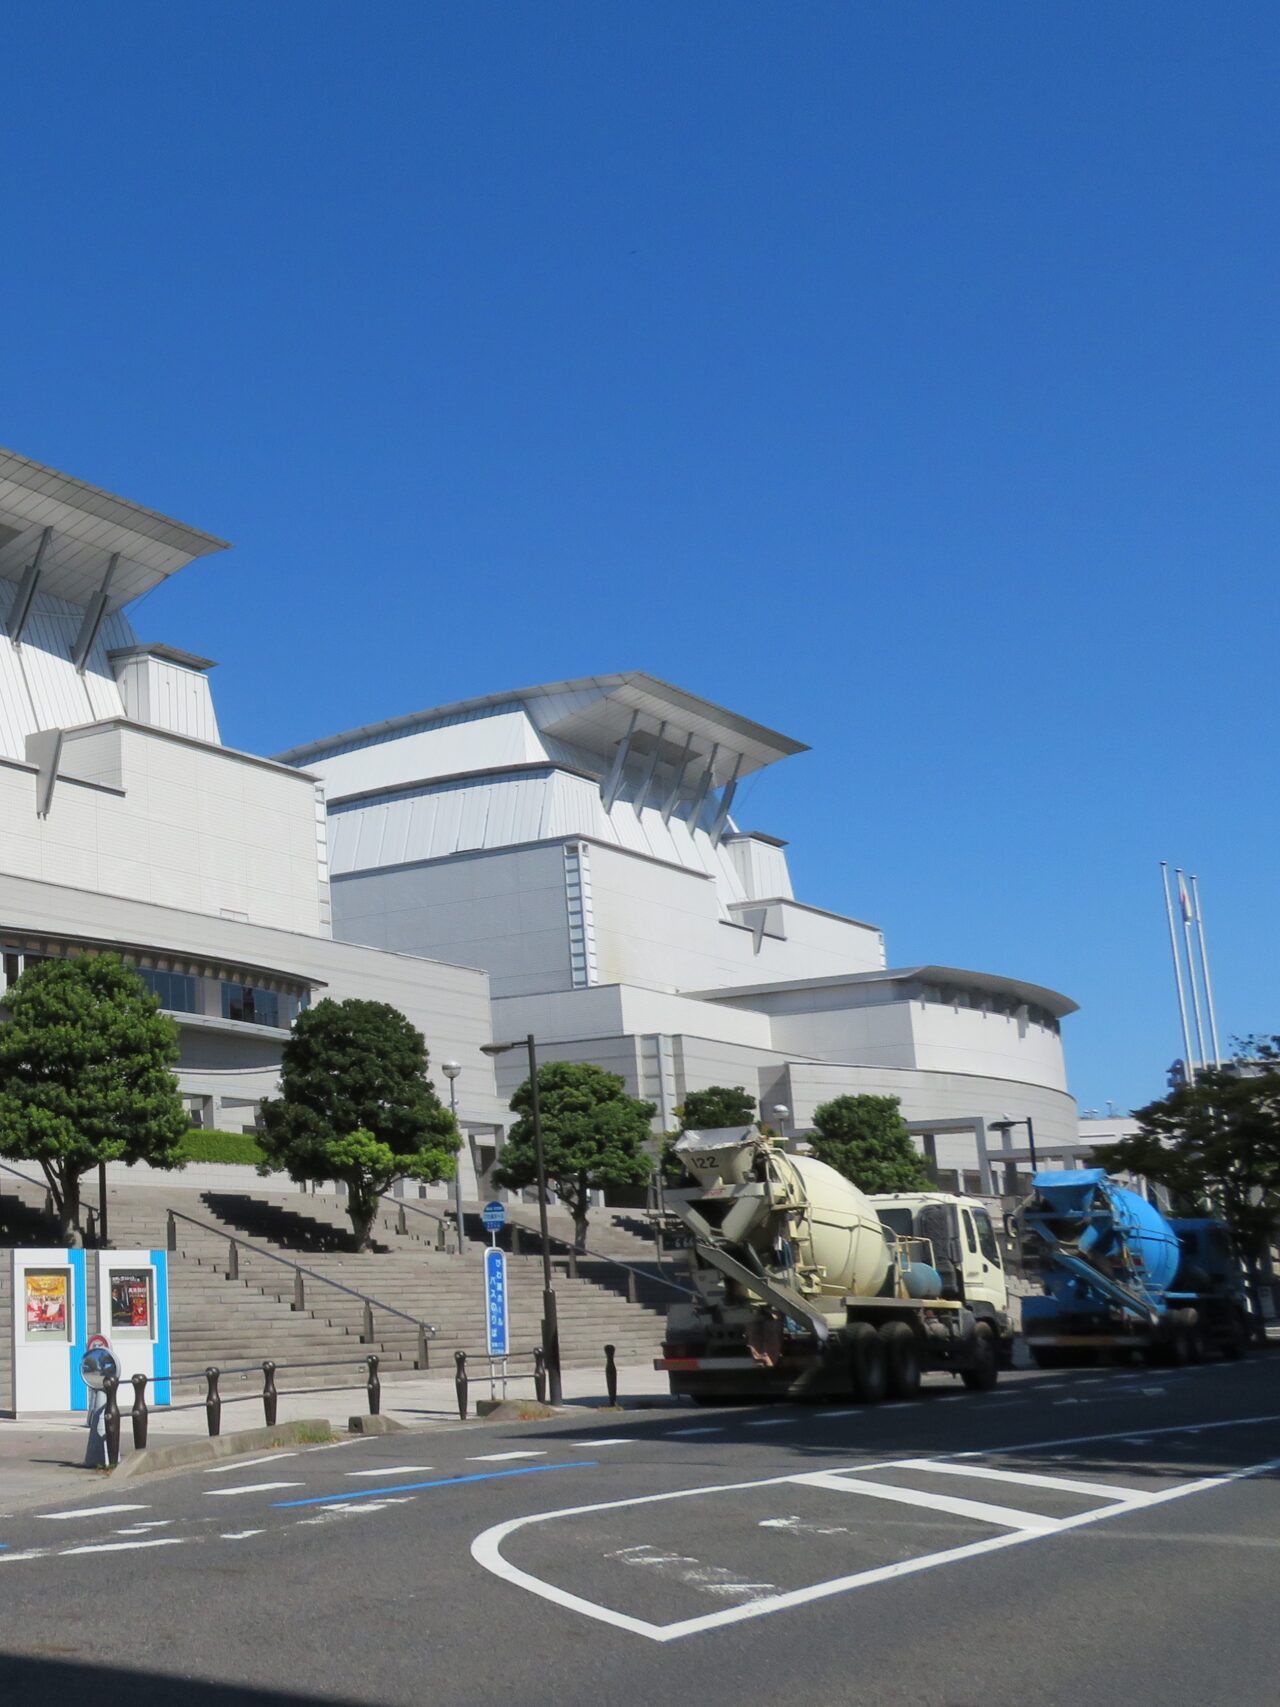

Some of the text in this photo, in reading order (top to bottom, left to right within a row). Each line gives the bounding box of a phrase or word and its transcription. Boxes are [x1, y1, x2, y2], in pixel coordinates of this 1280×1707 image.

[691, 1156, 719, 1169] 122
[489, 1276, 498, 1338] バスのりば
